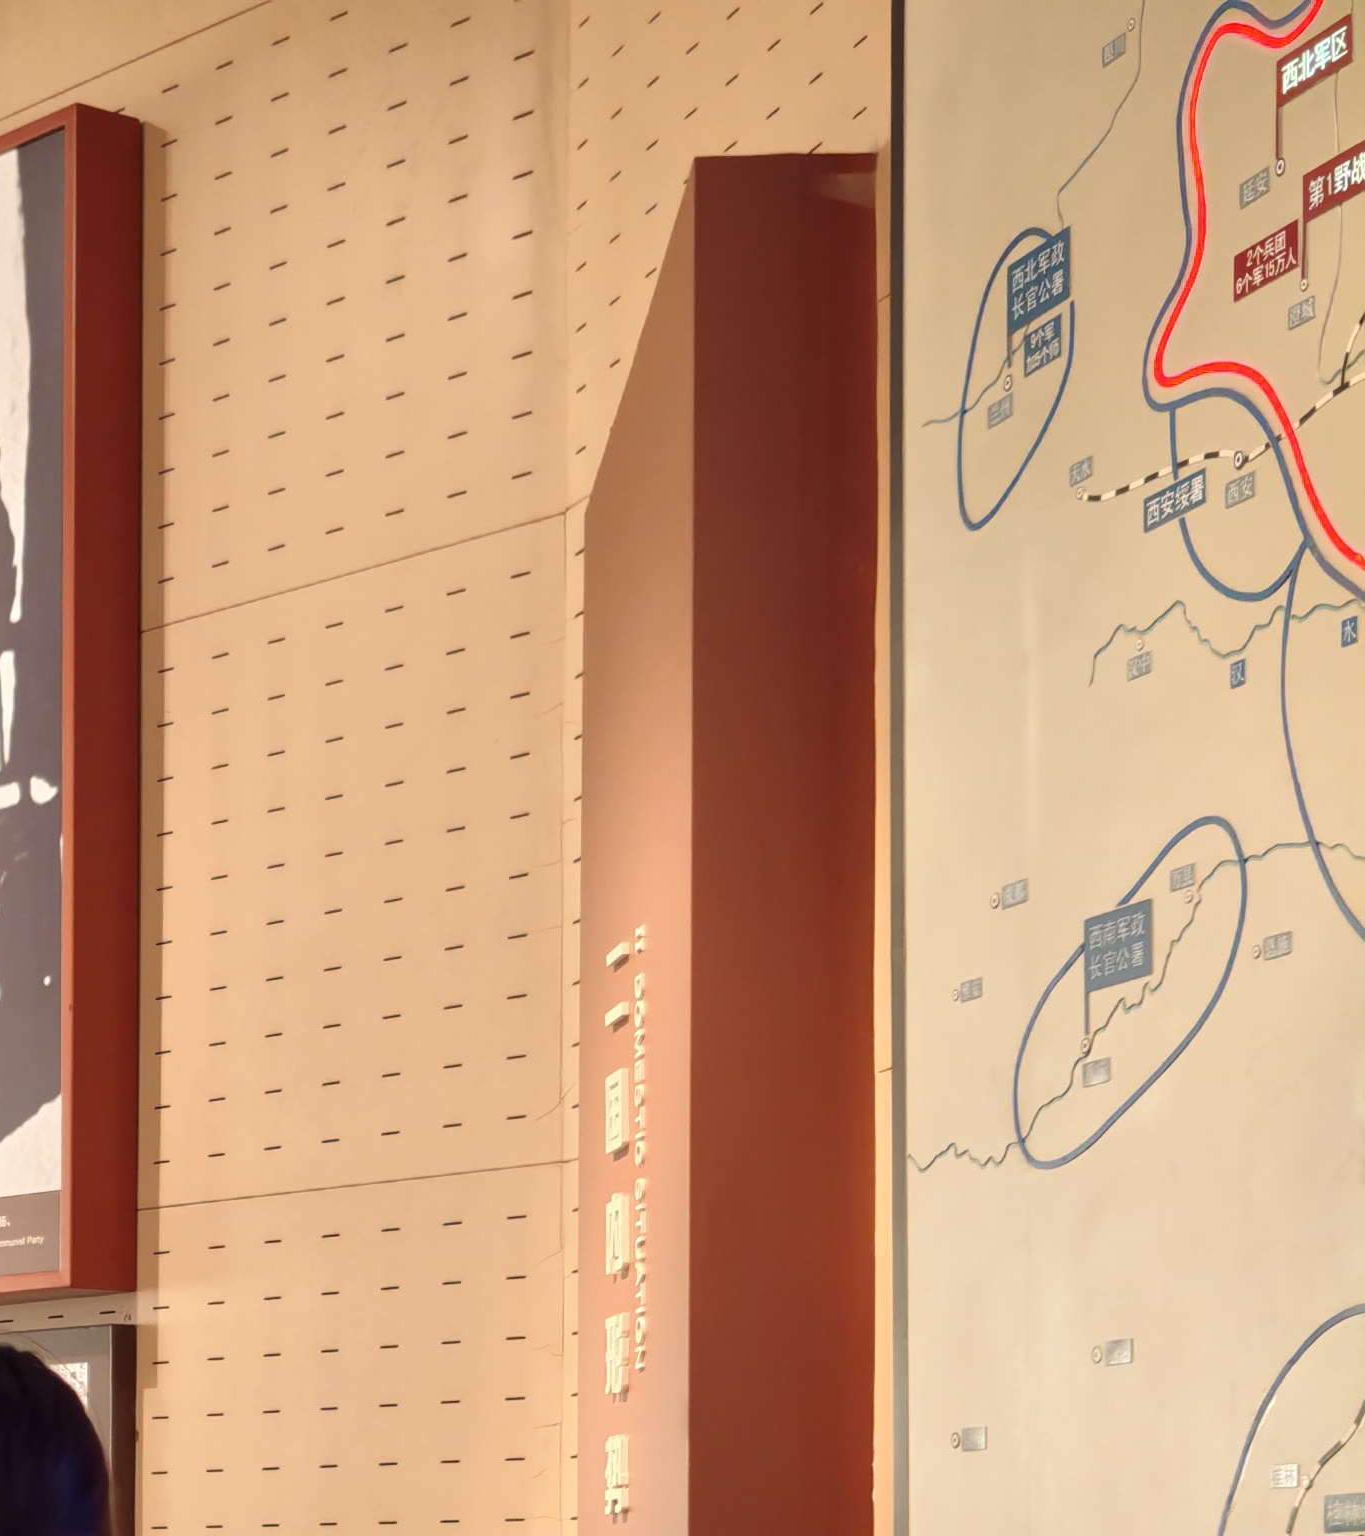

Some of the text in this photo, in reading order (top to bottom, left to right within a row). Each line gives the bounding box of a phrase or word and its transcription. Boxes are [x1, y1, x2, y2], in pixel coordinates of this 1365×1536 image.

[1281, 24, 1349, 95] 西北军区
[1011, 239, 1065, 293] 西北军政
[1235, 247, 1297, 296] 6个军15万人
[1246, 230, 1287, 268] 2个兵团
[1011, 269, 1065, 322] 长官公署
[1147, 475, 1204, 527] 西安绥署
[1227, 476, 1254, 504] 西安
[1344, 618, 1356, 642] 水
[1232, 662, 1244, 685] 汉
[1089, 911, 1145, 951] 西南军政
[1089, 941, 1144, 980] 长官公署
[633, 972, 647, 1168] DOMESTIC
[633, 1177, 647, 1373] SITUATION
